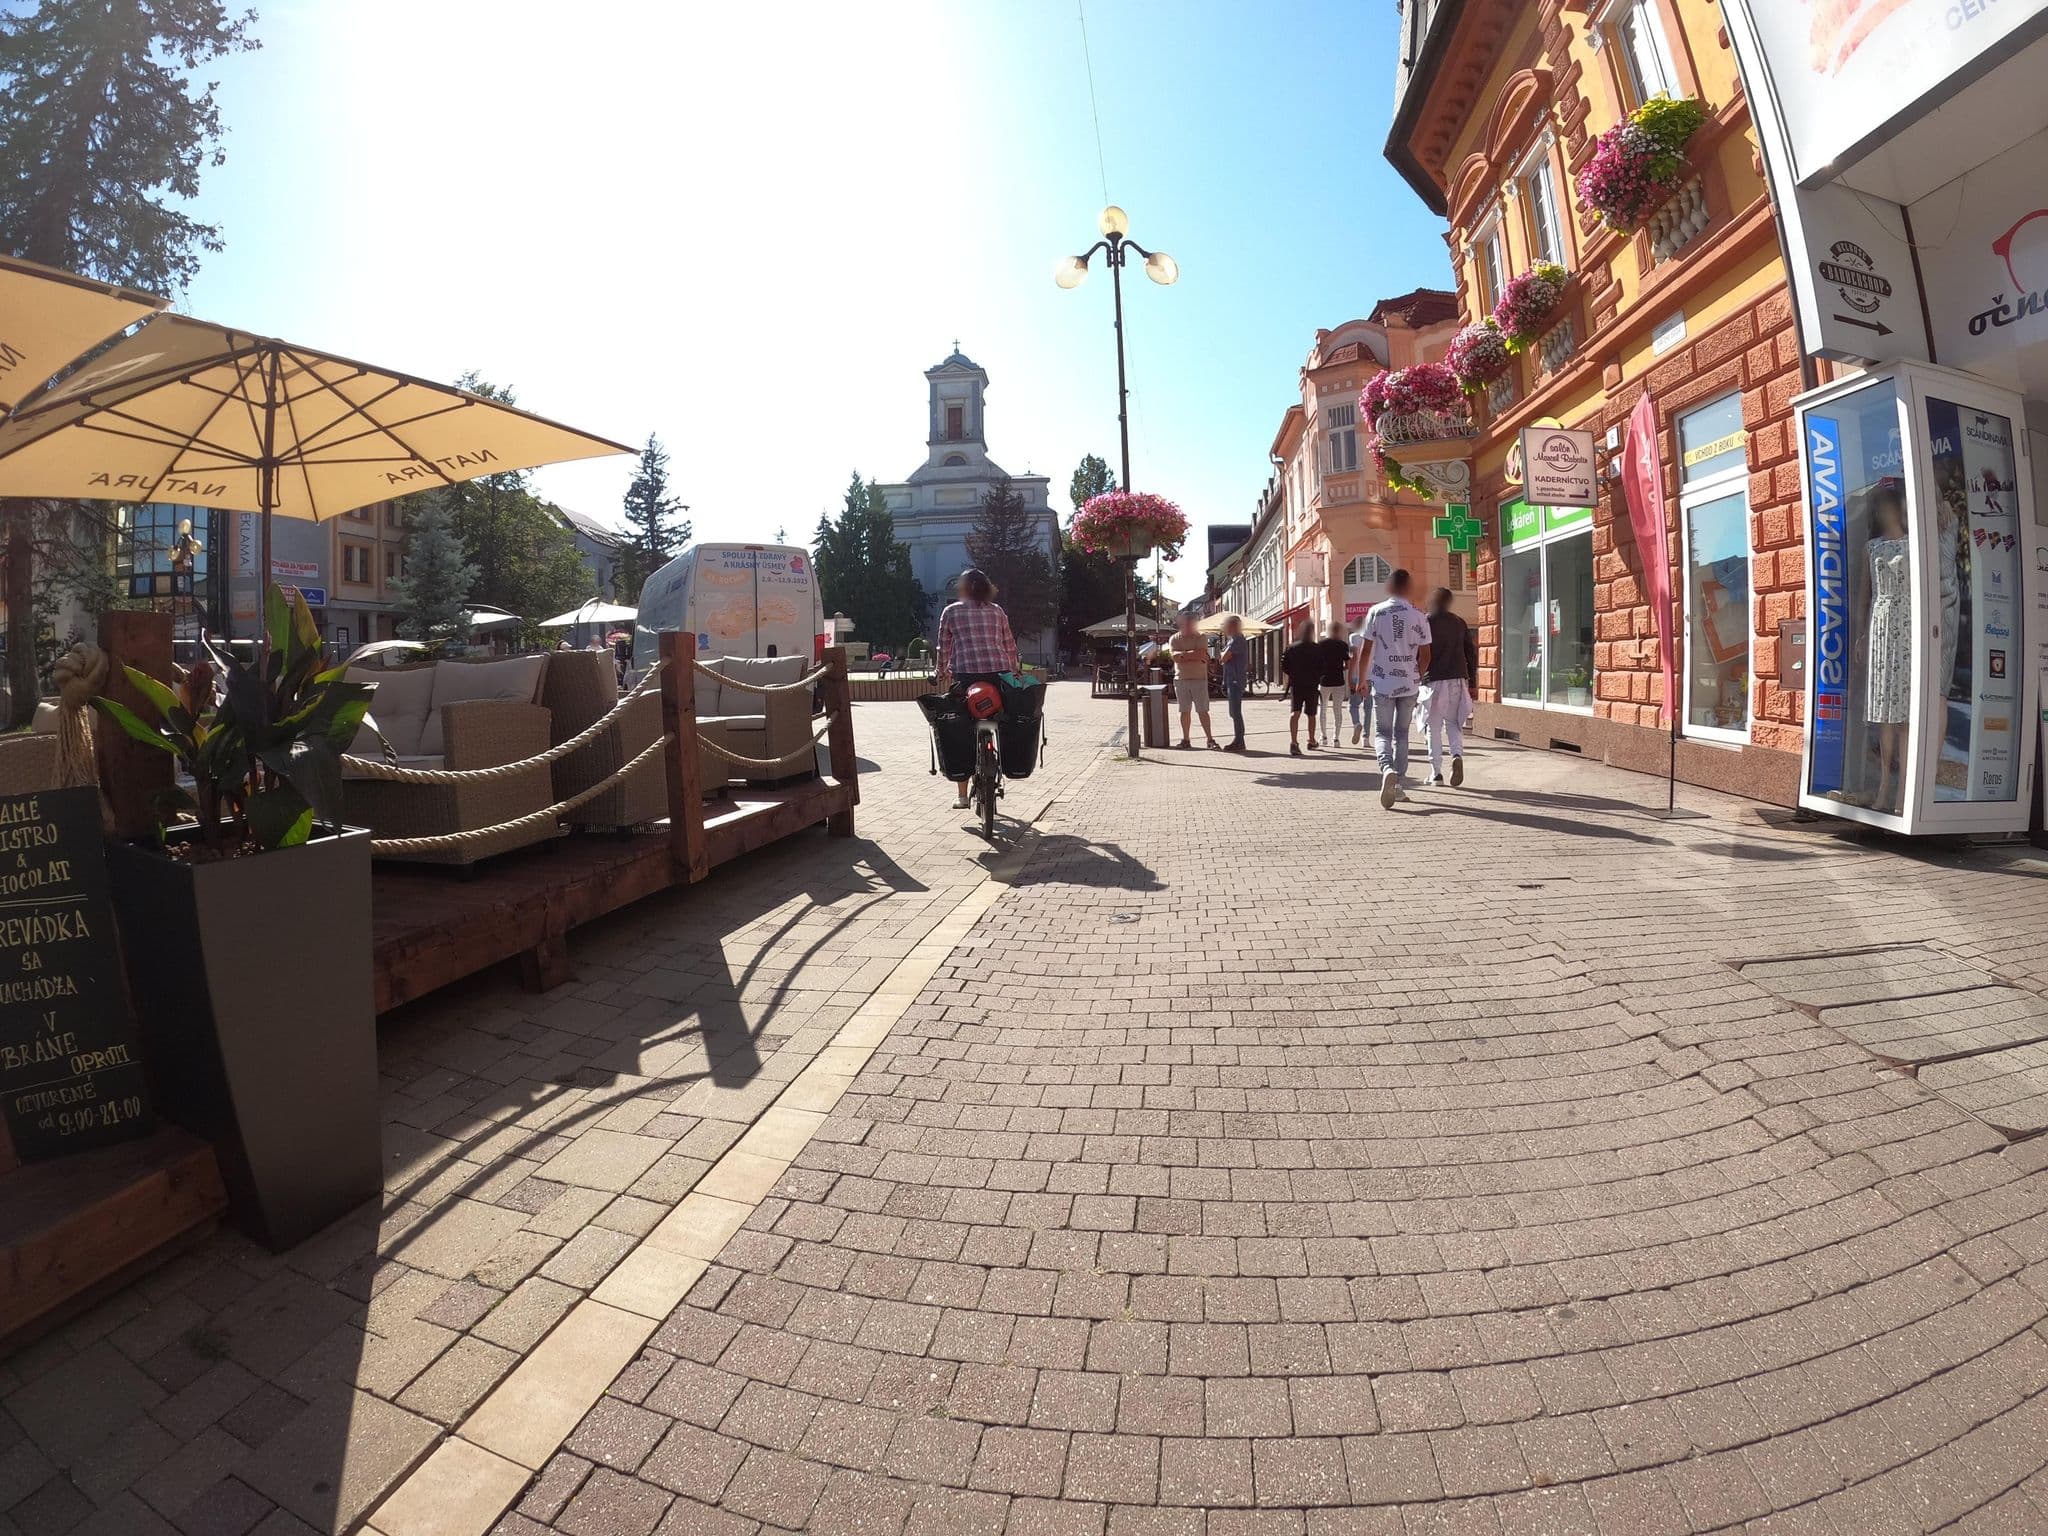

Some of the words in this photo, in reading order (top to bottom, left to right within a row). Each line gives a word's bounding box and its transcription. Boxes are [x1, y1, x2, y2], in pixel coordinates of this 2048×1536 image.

[1968, 289, 2048, 336] očn
[1534, 475, 1590, 485] KADERNÍCTVO
[16, 852, 28, 868] &
[21, 951, 43, 971] SA
[42, 1010, 57, 1032] V
[15, 1075, 97, 1115] OTVORENÉ
[38, 1112, 56, 1129] od
